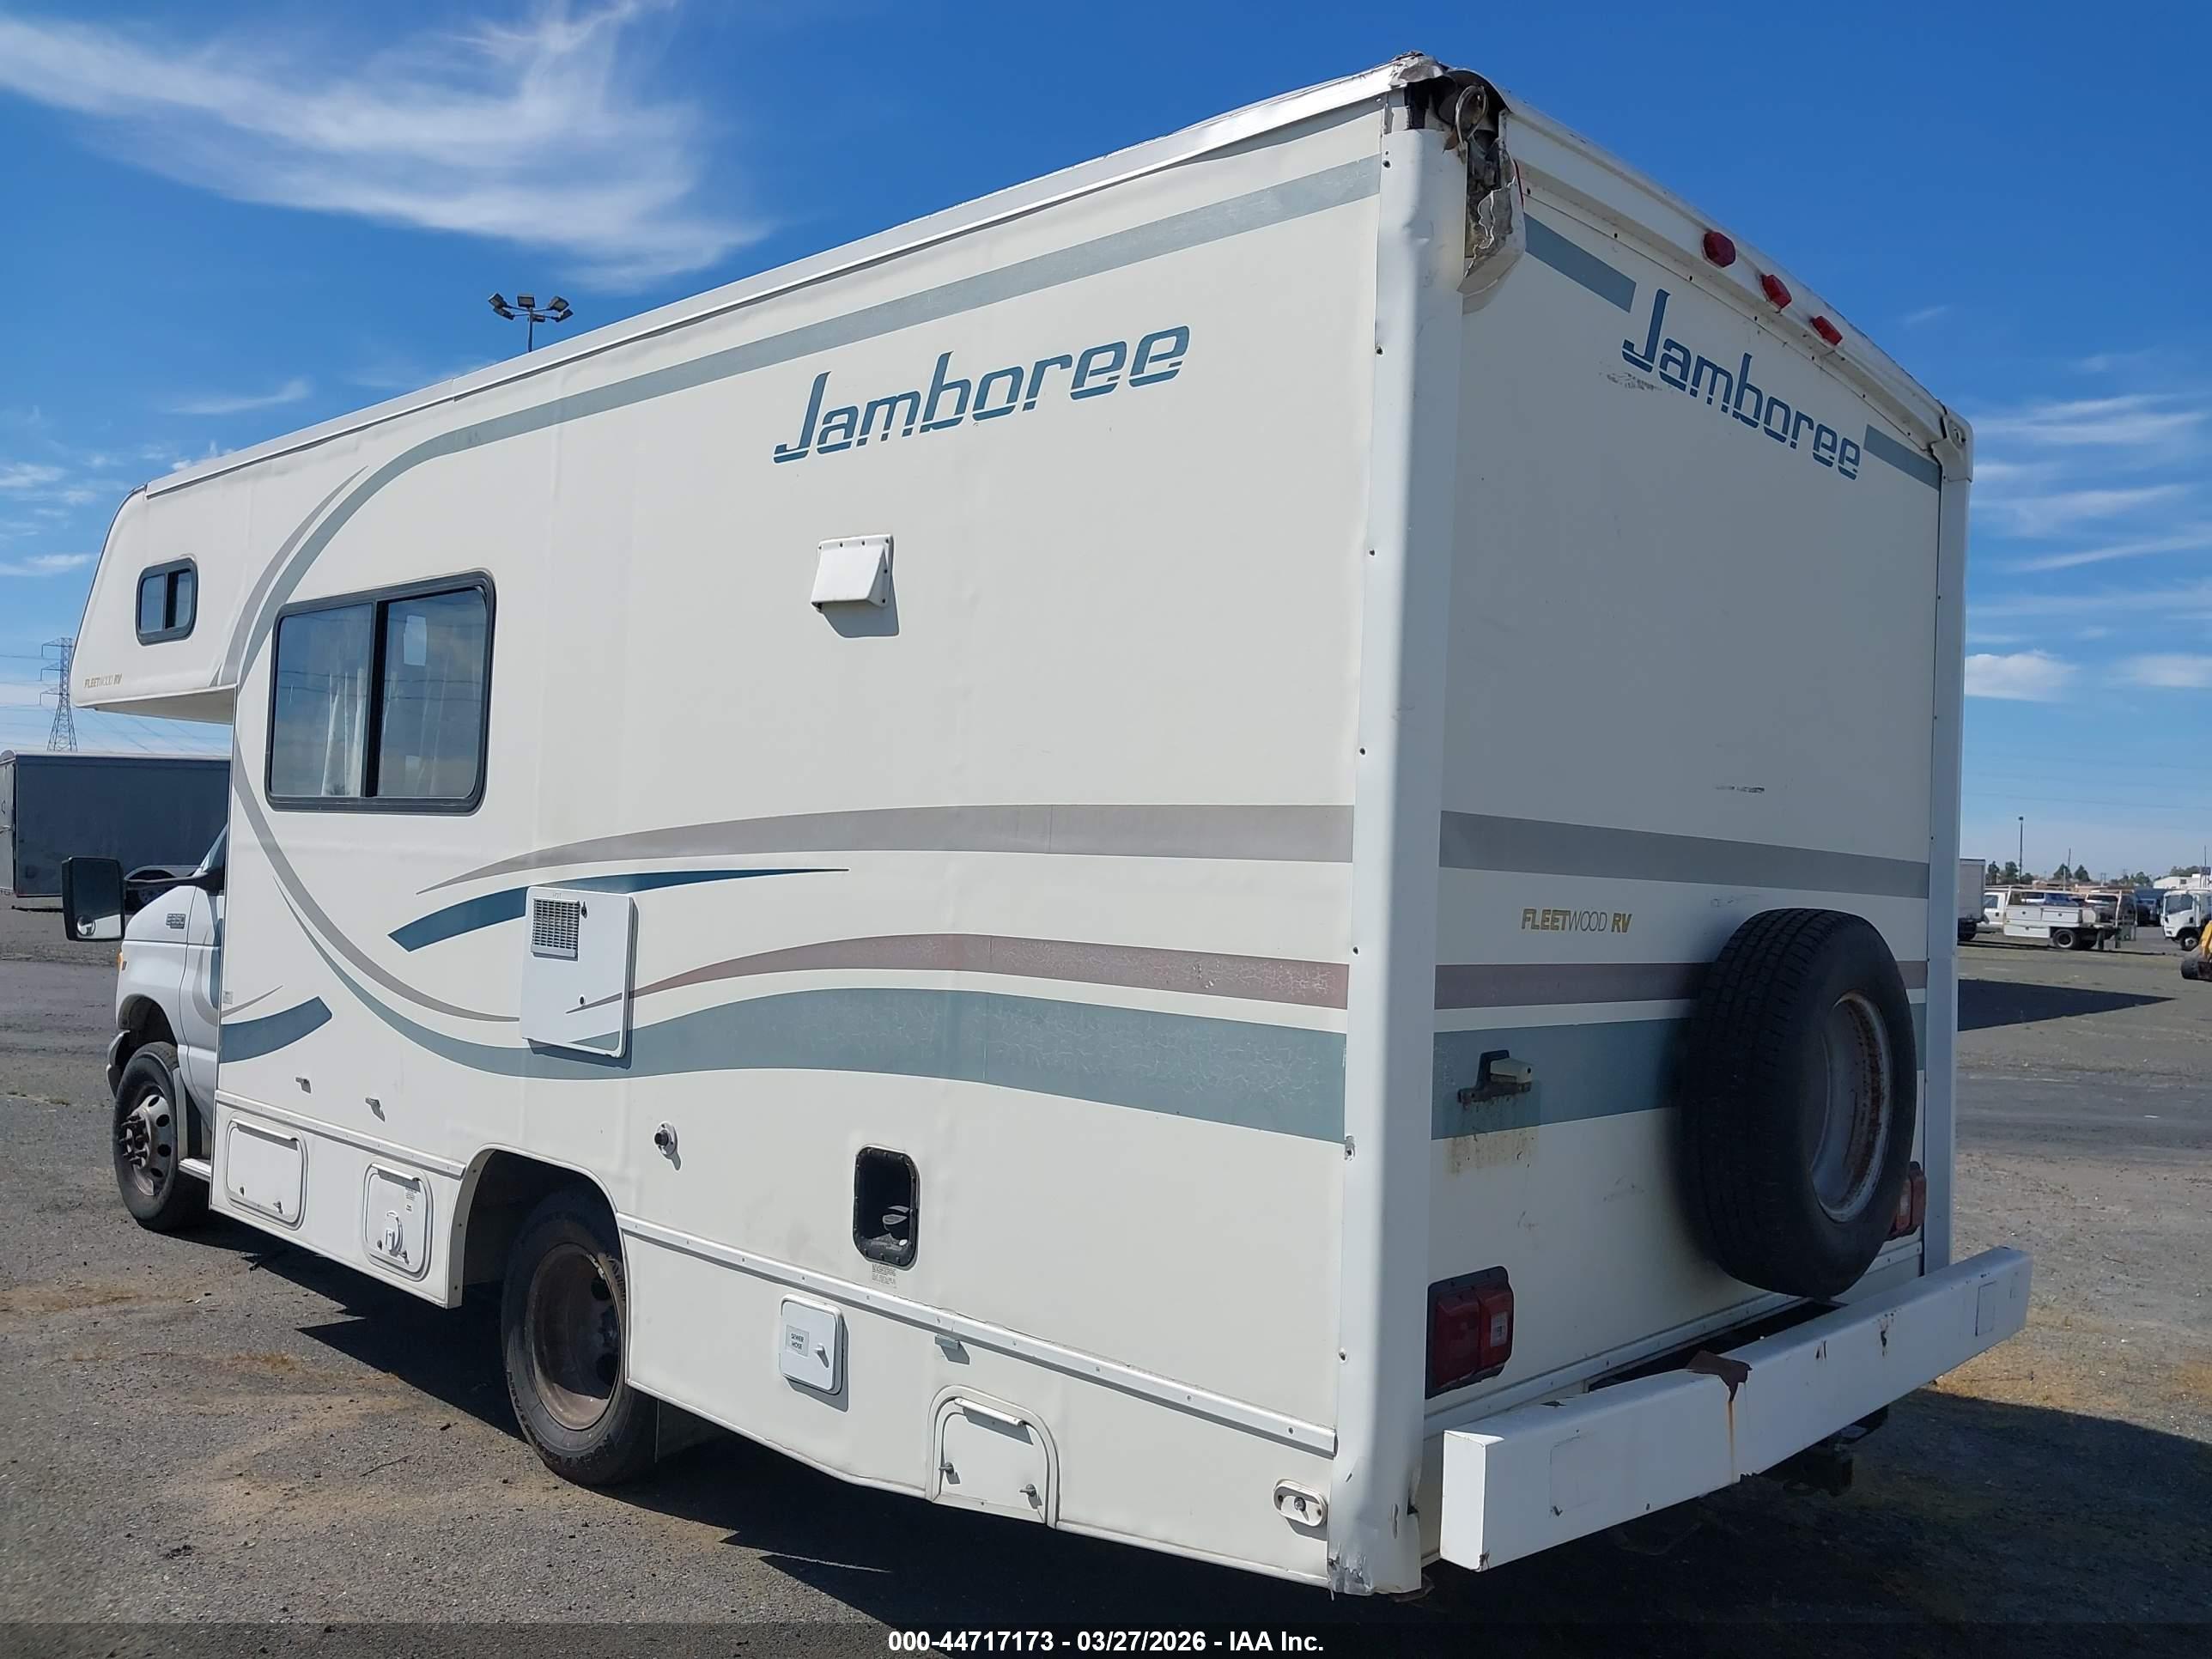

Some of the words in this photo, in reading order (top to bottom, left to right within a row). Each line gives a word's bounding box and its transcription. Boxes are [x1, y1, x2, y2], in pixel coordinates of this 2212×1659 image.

[773, 325, 1190, 465] Jamboree
[1622, 289, 1861, 482] Jamboree
[1522, 908, 1607, 933] FLEETWOOD
[1611, 912, 1632, 933] RV
